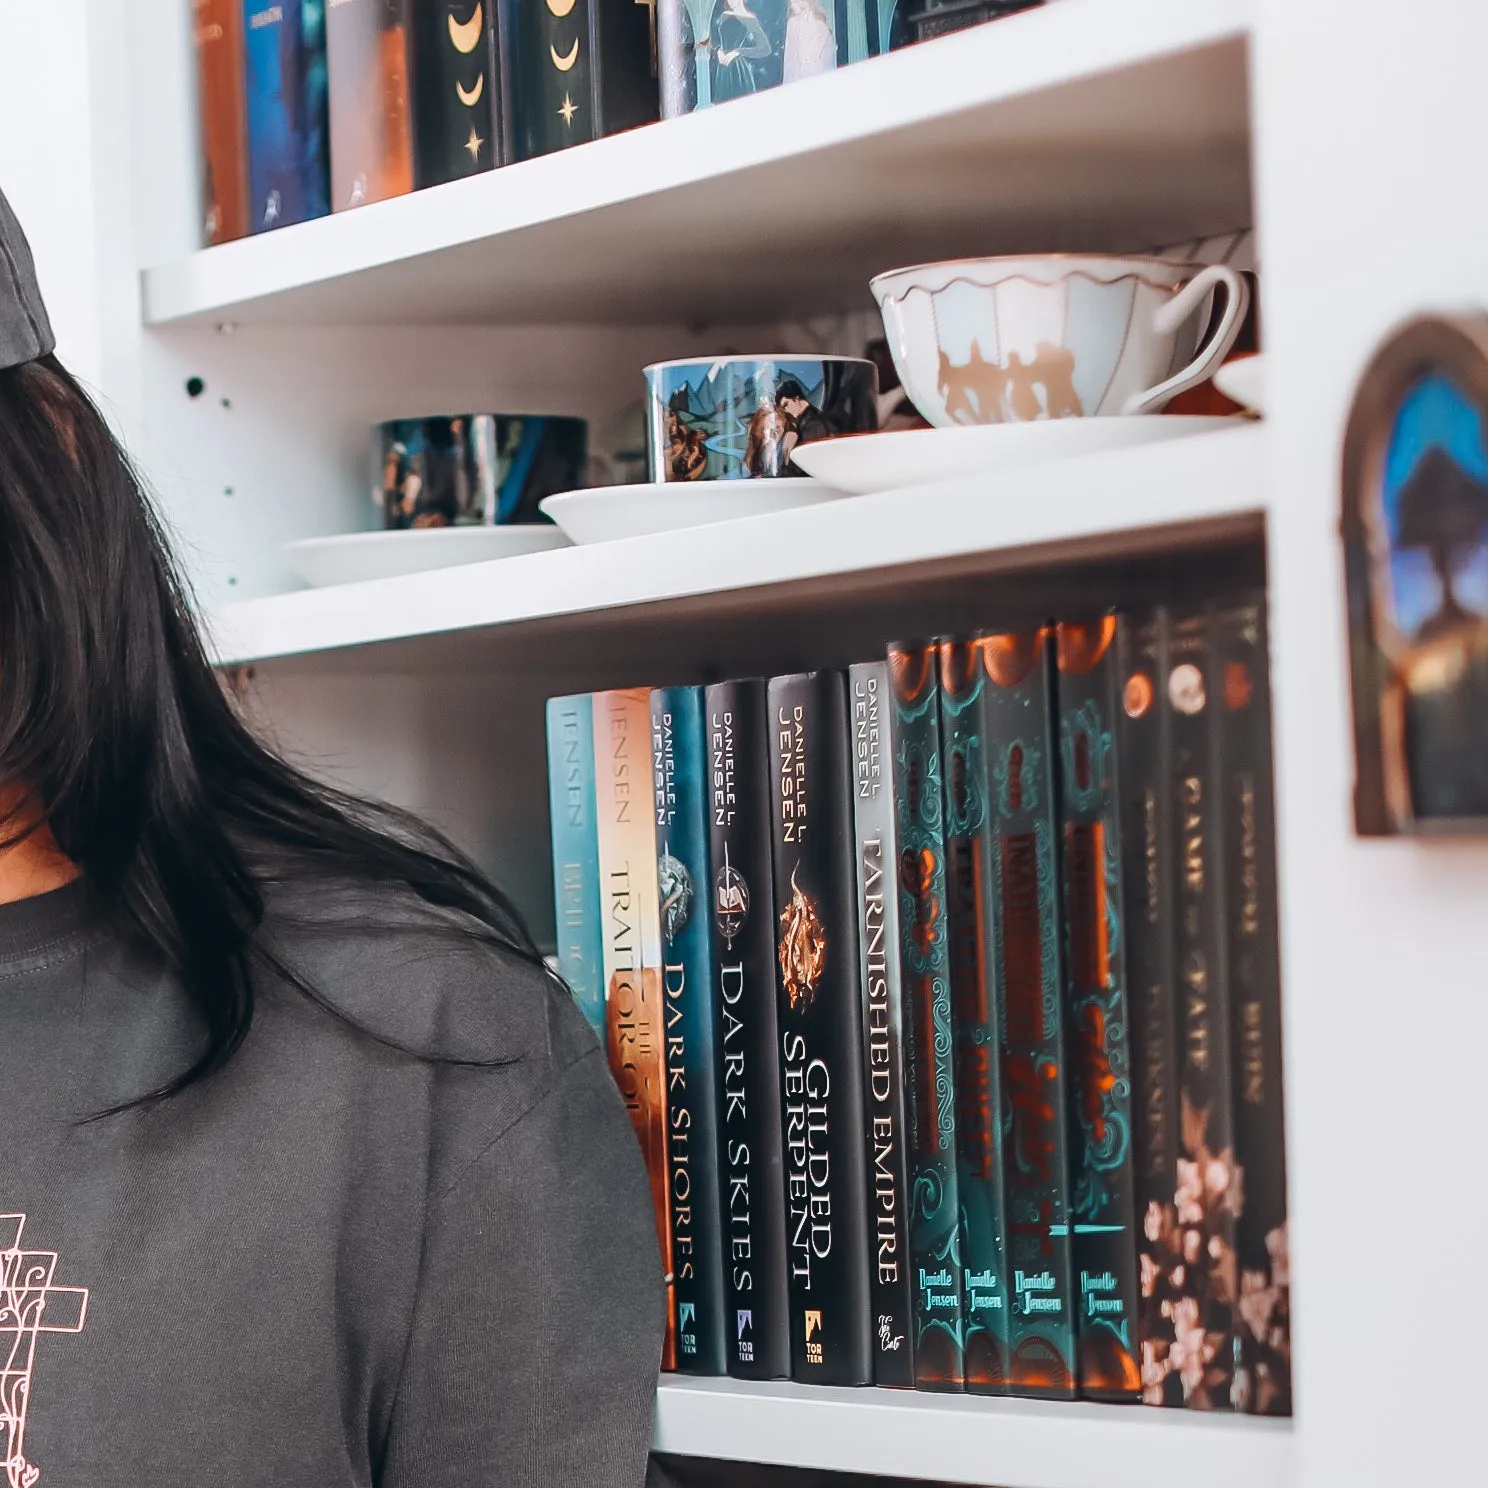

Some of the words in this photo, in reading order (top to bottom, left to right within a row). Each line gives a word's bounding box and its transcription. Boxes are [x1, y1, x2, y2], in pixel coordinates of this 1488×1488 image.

[608, 705, 632, 826] JENSEN
[653, 714, 666, 826] JENSEN
[663, 713, 676, 804] DANIELLE
[713, 713, 725, 826] JENSEN
[724, 713, 736, 805] DANIELLE
[779, 707, 795, 843] JENSEN
[793, 706, 807, 820] DANIELLE
[855, 682, 870, 799] JENSEN
[868, 679, 881, 776] DANIELLE
[610, 860, 638, 1046] TRAITOR
[862, 836, 891, 1102] TARNISHED
[665, 962, 686, 1093] DARK
[720, 960, 747, 1124] DARK
[669, 1106, 694, 1281] SHORES
[783, 1030, 812, 1291] SERPENT
[806, 1058, 832, 1258] GILDED
[873, 1115, 898, 1285] EMPIRE
[728, 1140, 753, 1292] SKIES
[918, 1269, 953, 1290] Danielle
[925, 1288, 960, 1312] Jensen
[964, 1269, 997, 1290] Danielle
[970, 1289, 1002, 1313] Jensen
[1014, 1270, 1056, 1293] Danielle
[1023, 1291, 1062, 1315] Jensen
[738, 1341, 753, 1351] TOR
[806, 1343, 822, 1354] TOR
[806, 1354, 823, 1364] TEEN
